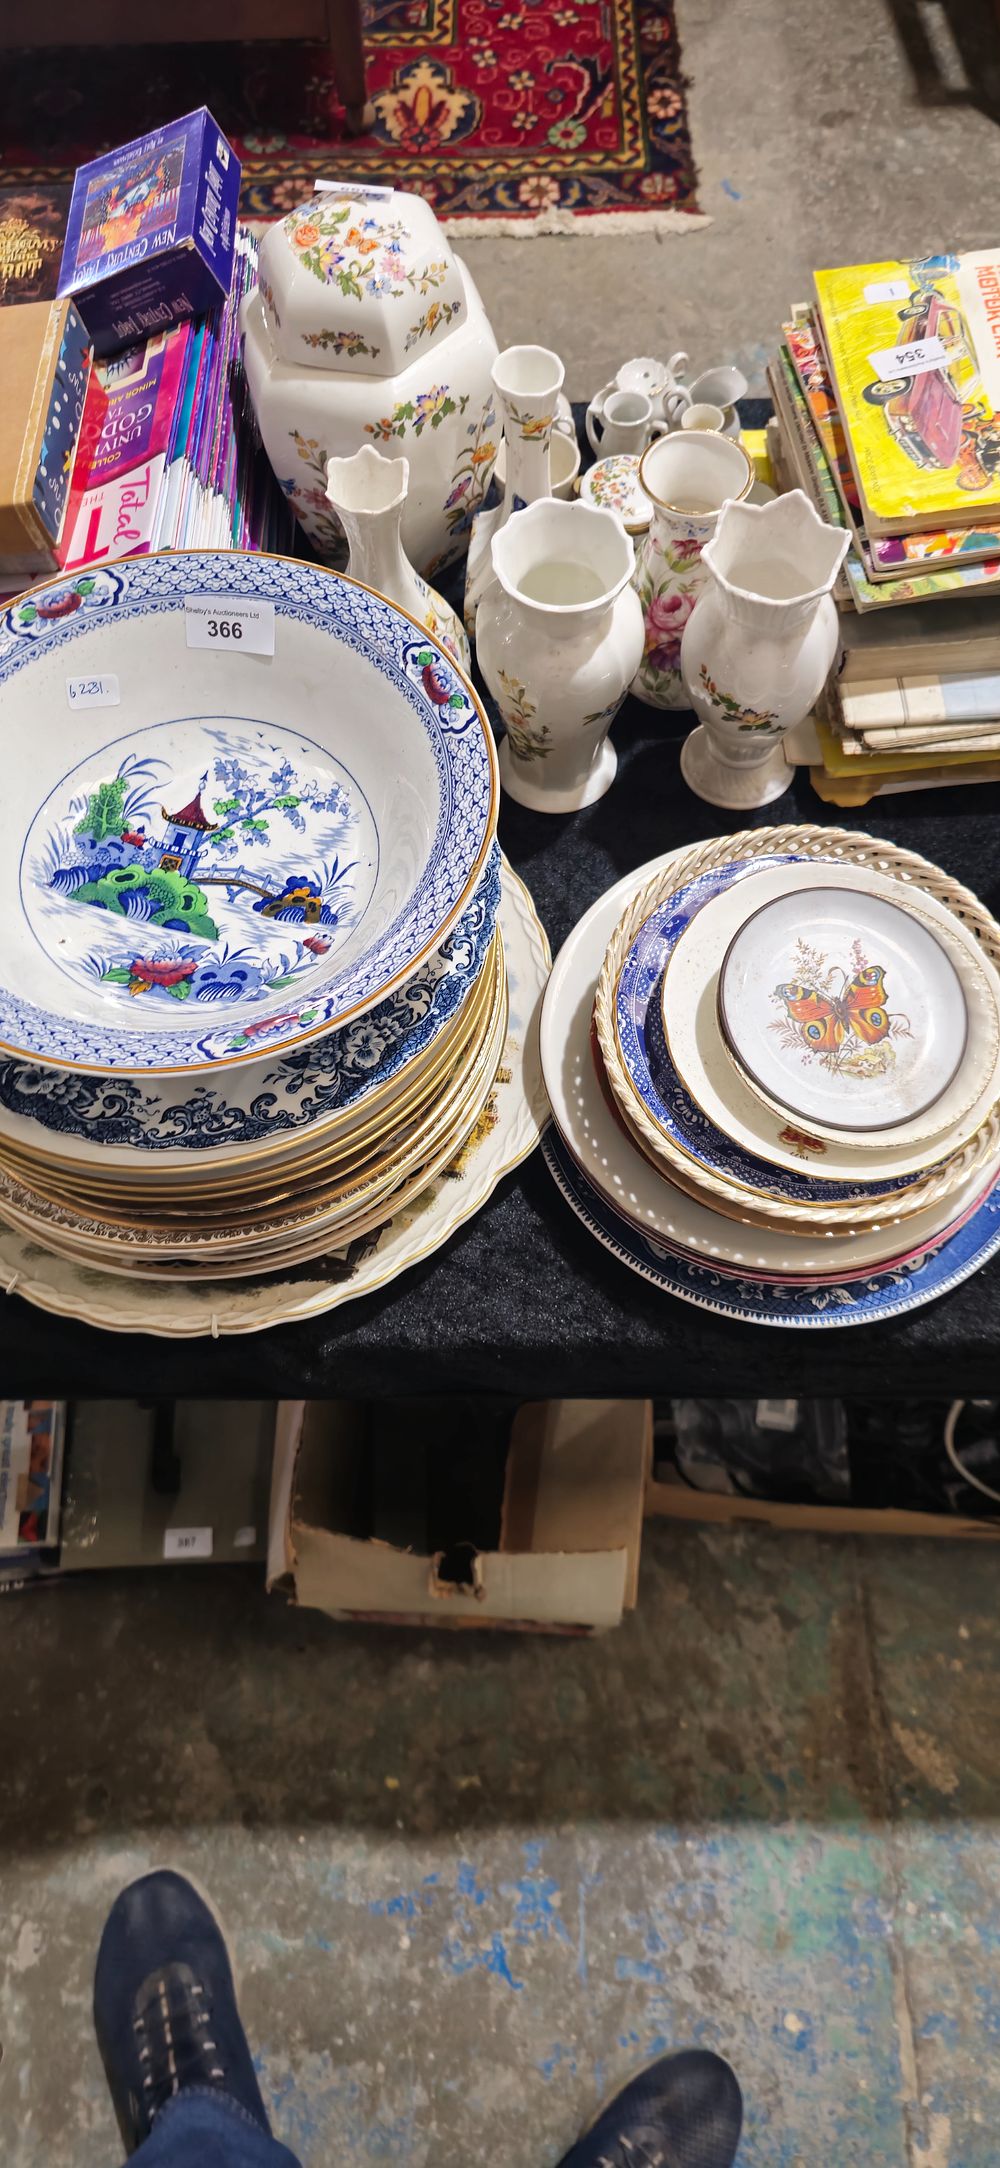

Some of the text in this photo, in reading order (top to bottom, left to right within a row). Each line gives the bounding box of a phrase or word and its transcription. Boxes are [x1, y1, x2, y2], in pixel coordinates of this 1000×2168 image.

[152, 224, 177, 250] NEW
[102, 238, 149, 269] CENTURY
[895, 348, 926, 364] 354
[125, 378, 157, 400] MINOR
[113, 466, 150, 545] Total
[186, 606, 211, 615] Shelby's
[213, 609, 248, 618] Auctioneers
[207, 620, 243, 639] 366
